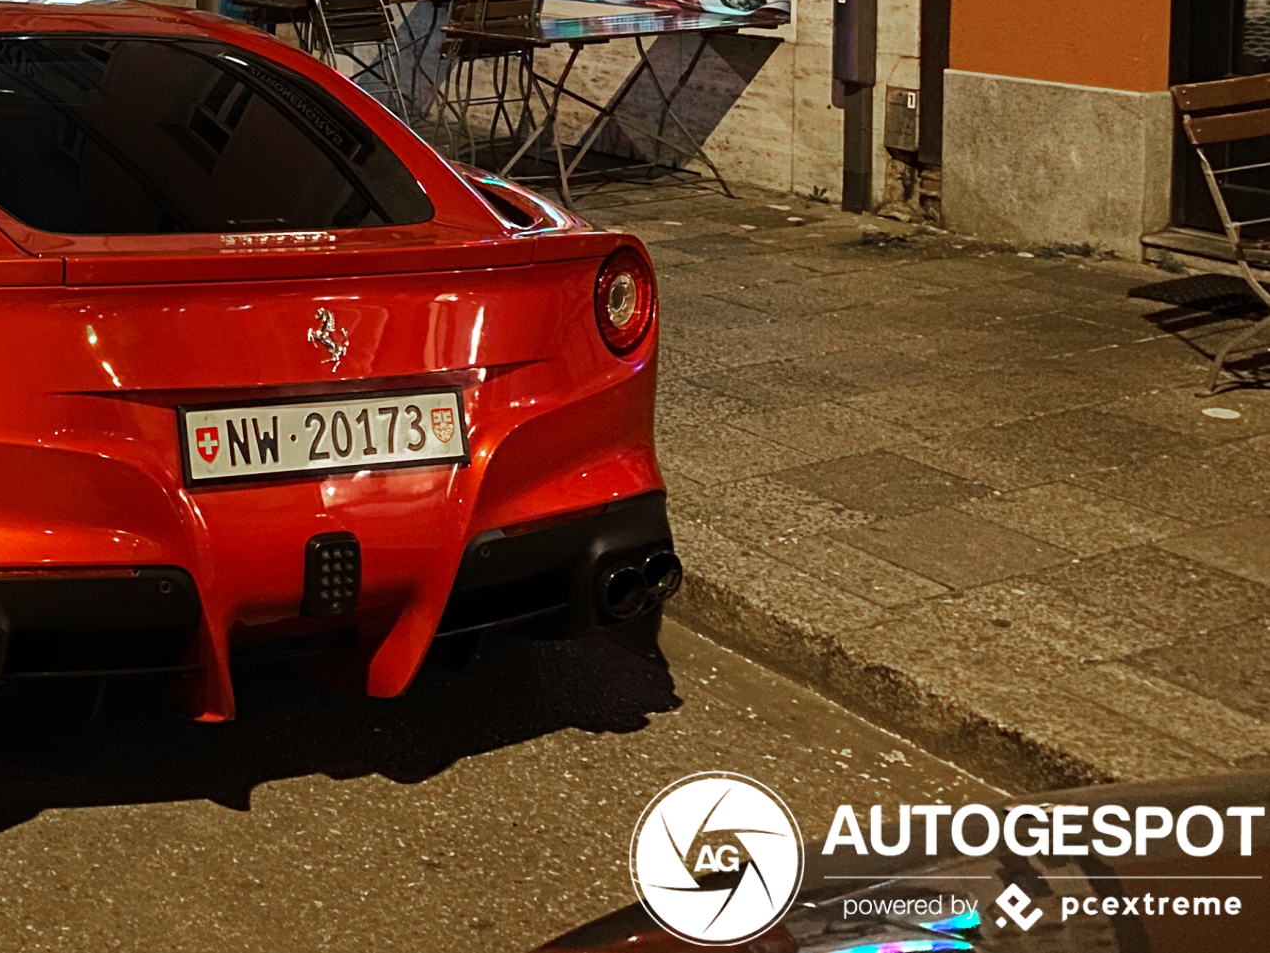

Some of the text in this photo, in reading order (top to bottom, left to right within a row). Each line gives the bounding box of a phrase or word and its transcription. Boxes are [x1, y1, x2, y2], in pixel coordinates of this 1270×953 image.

[909, 95, 915, 106] 1
[226, 415, 279, 466] NW
[305, 404, 426, 461] 20173
